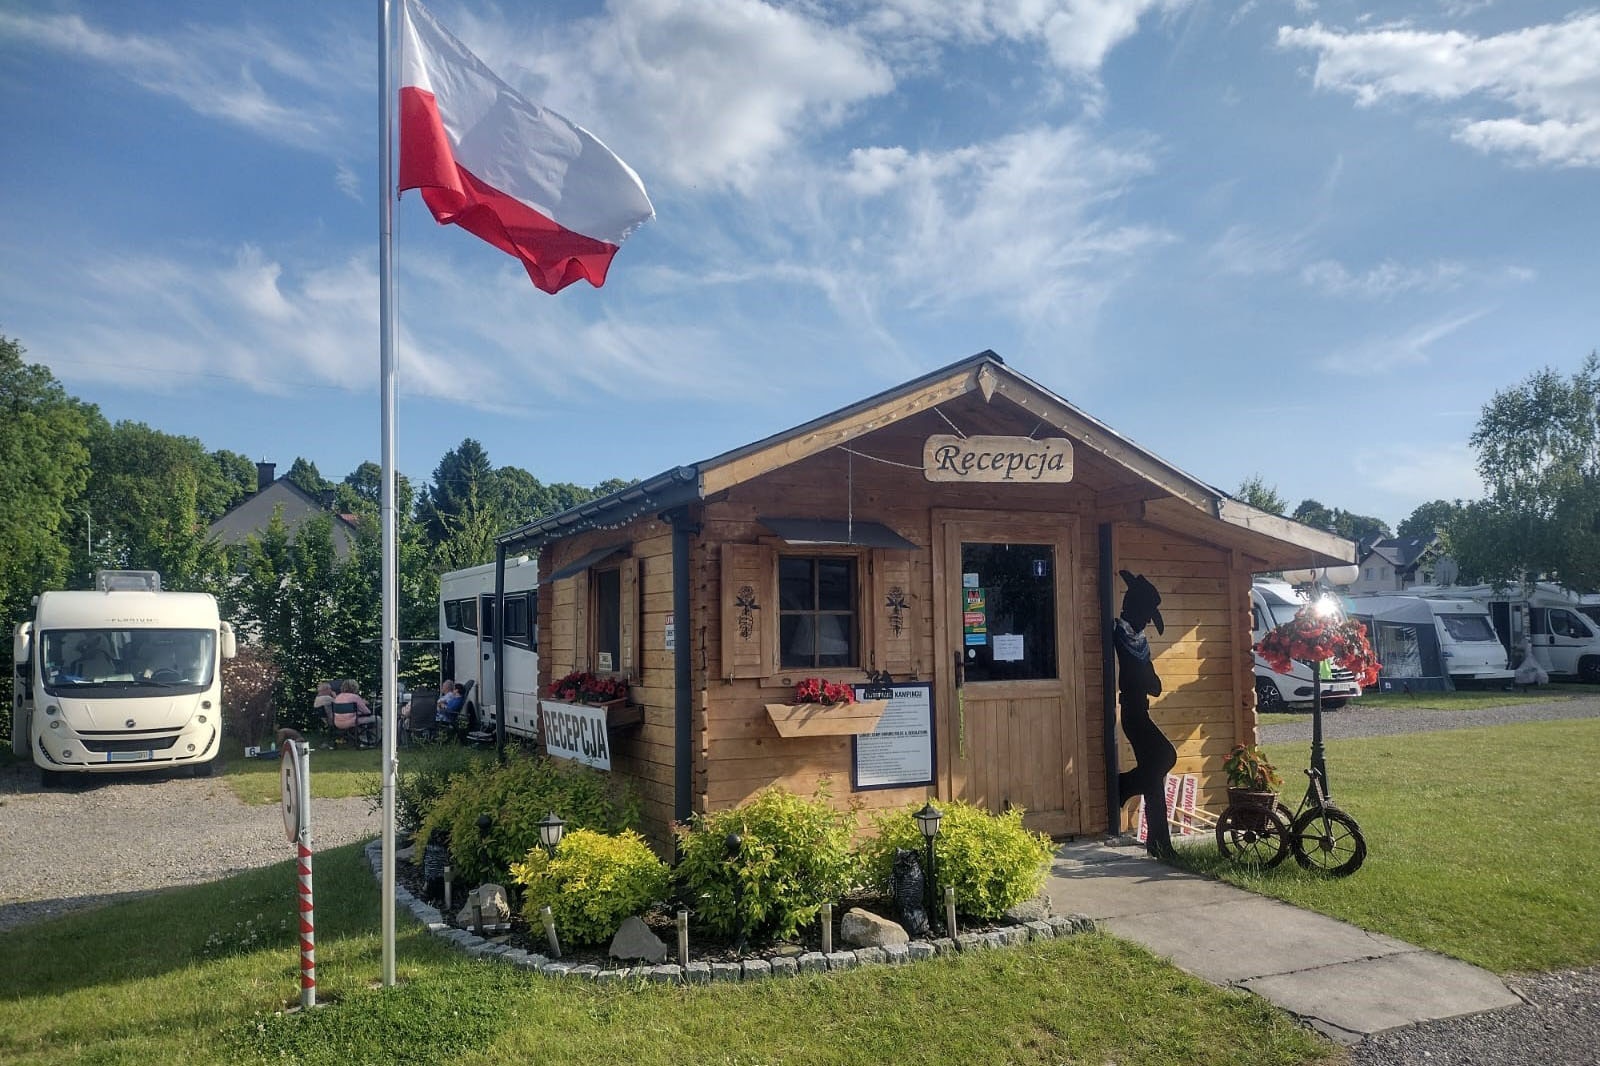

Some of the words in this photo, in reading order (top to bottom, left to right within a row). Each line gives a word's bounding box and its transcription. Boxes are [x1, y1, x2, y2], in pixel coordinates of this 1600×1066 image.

[935, 445, 1064, 480] Recepcja
[249, 747, 256, 756] 6
[543, 710, 608, 760] RECEPCJA
[286, 768, 292, 814] 5
